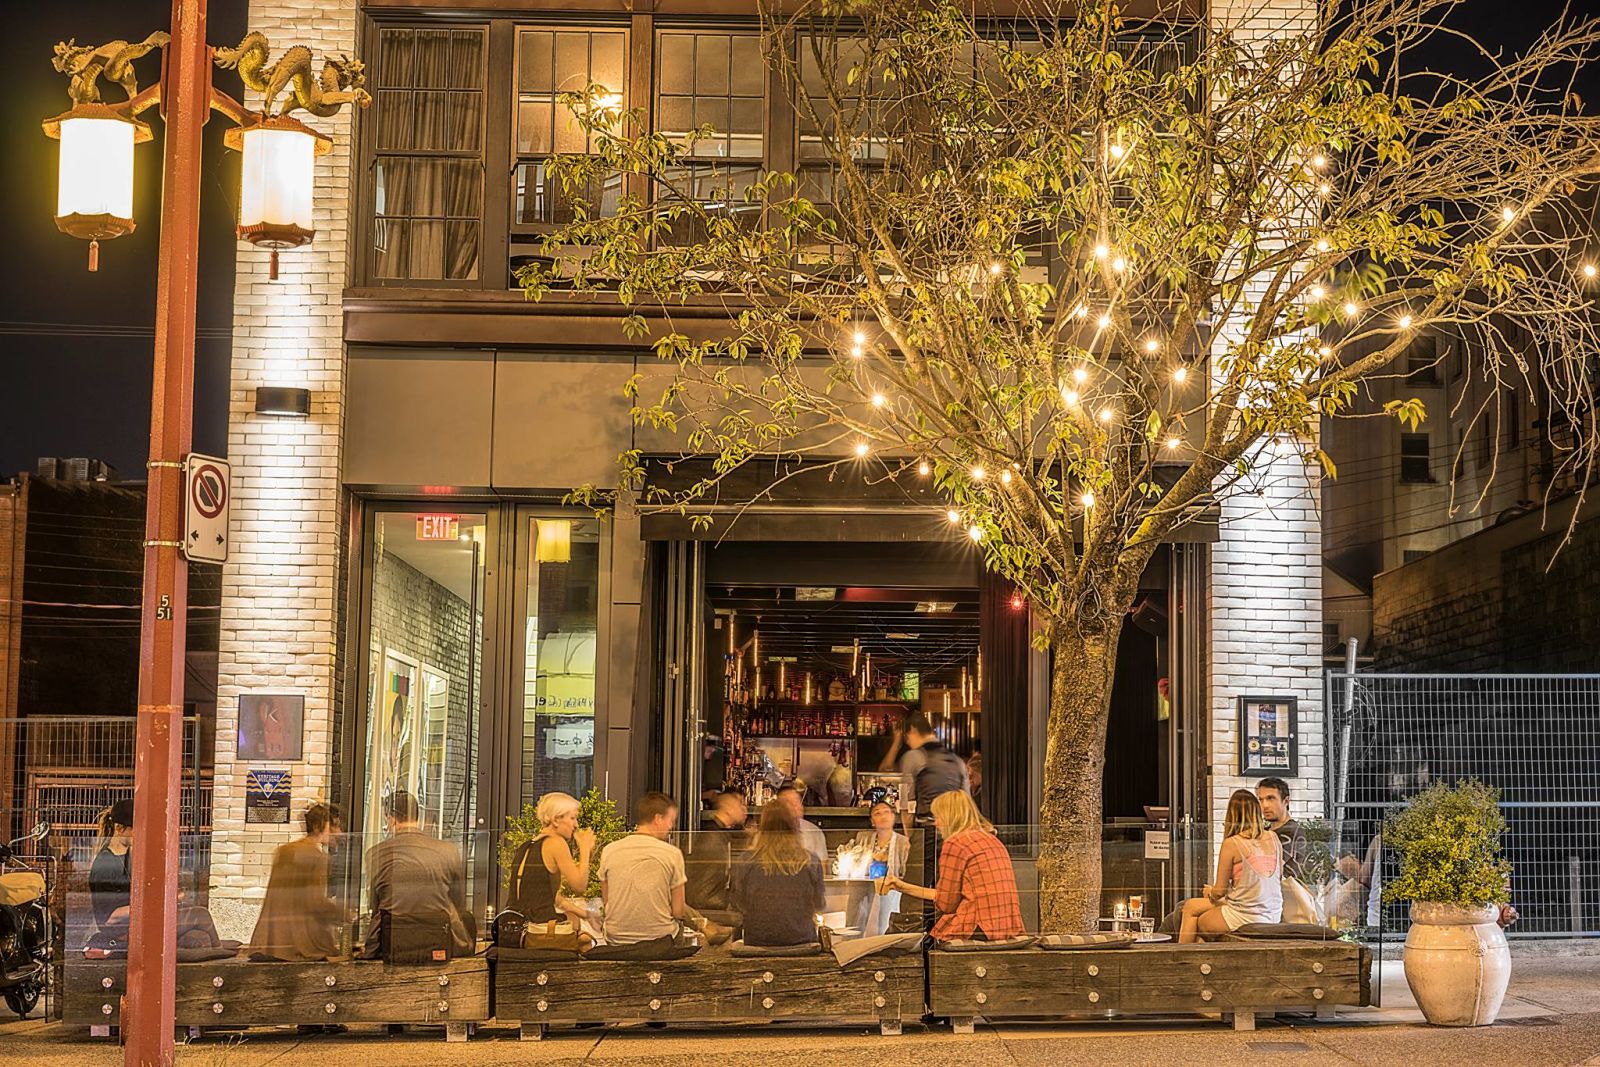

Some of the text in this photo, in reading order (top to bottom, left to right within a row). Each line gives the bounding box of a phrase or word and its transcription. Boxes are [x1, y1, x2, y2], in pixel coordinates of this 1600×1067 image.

[423, 516, 452, 538] EXIT
[161, 594, 169, 607] 5
[157, 607, 170, 620] 51
